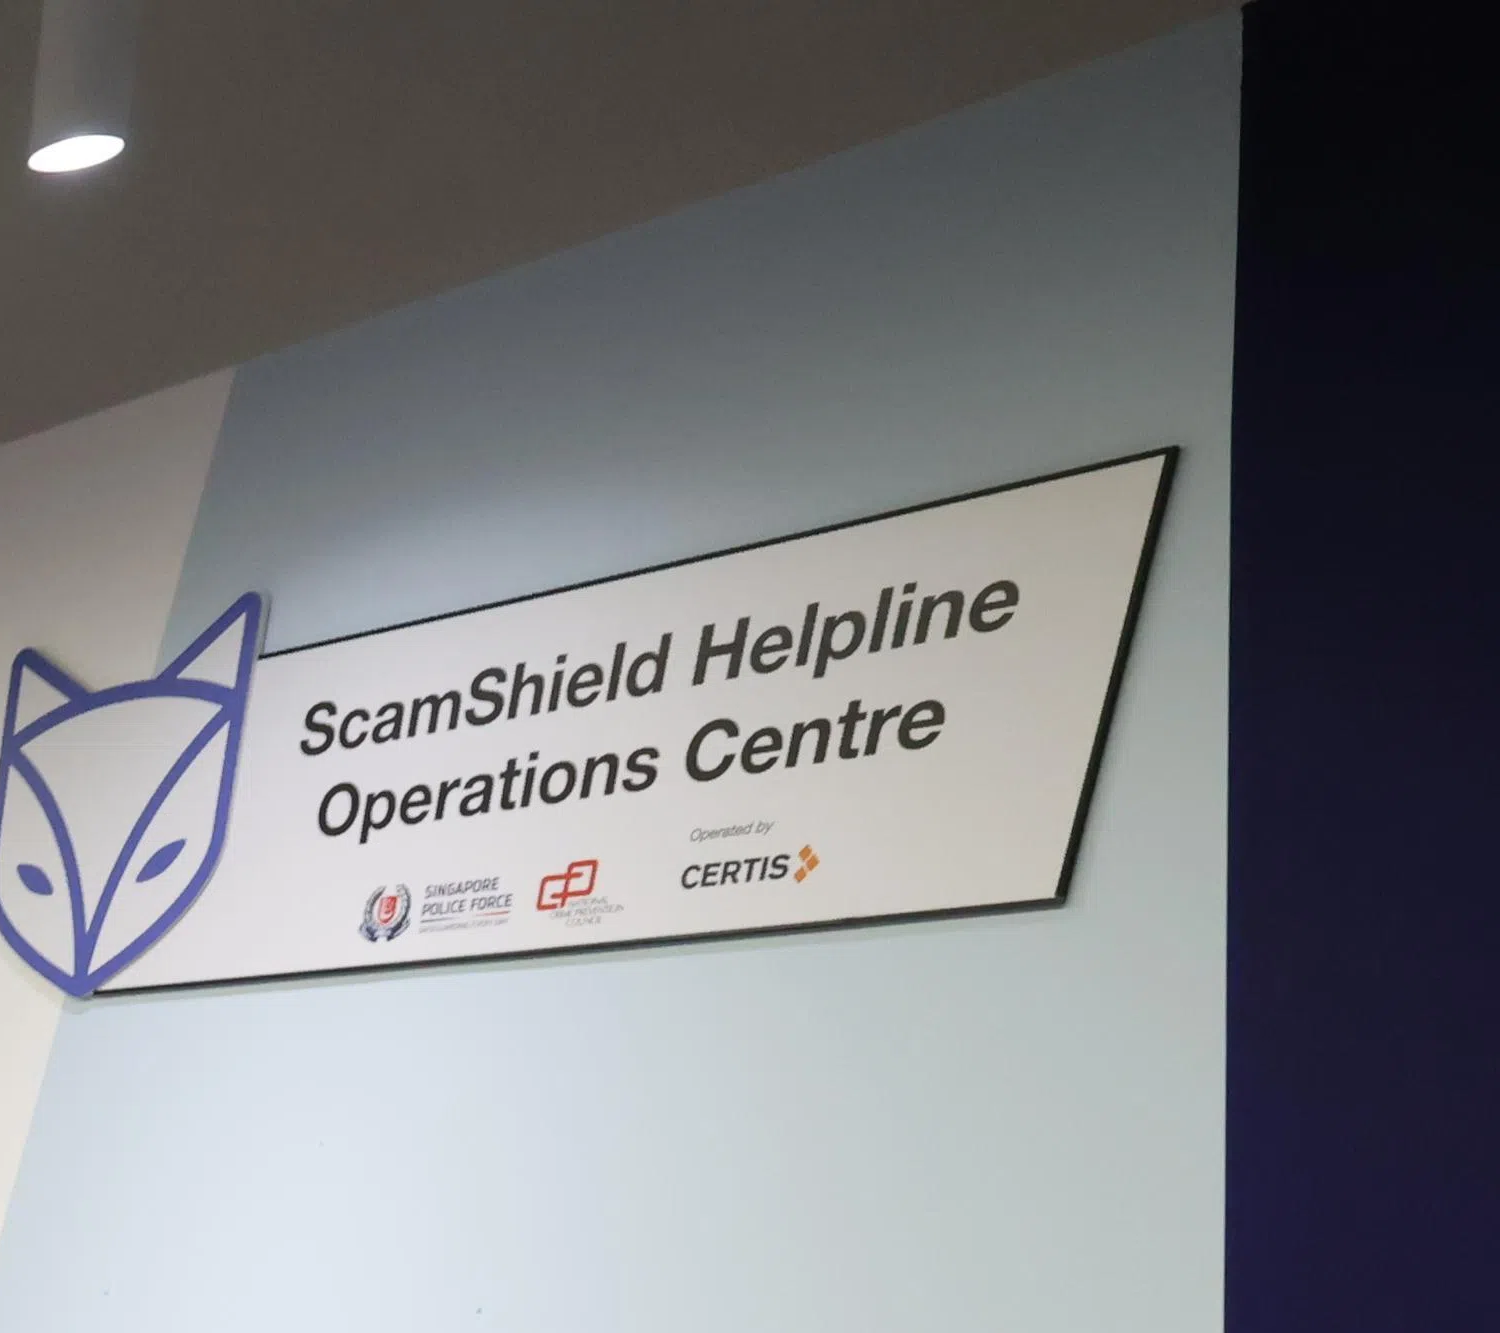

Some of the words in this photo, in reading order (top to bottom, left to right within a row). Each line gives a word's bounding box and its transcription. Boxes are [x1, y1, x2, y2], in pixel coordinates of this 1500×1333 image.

[300, 633, 672, 756] ScamShield
[691, 579, 1021, 686] Helpline
[317, 744, 659, 844] Operations
[685, 699, 947, 782] Centre
[689, 821, 753, 843] Operated
[755, 820, 776, 836] by
[680, 854, 791, 889] CERTIS
[424, 876, 501, 899] SINGAPORE
[421, 898, 465, 917] POLICE
[469, 893, 513, 912] FORCE
